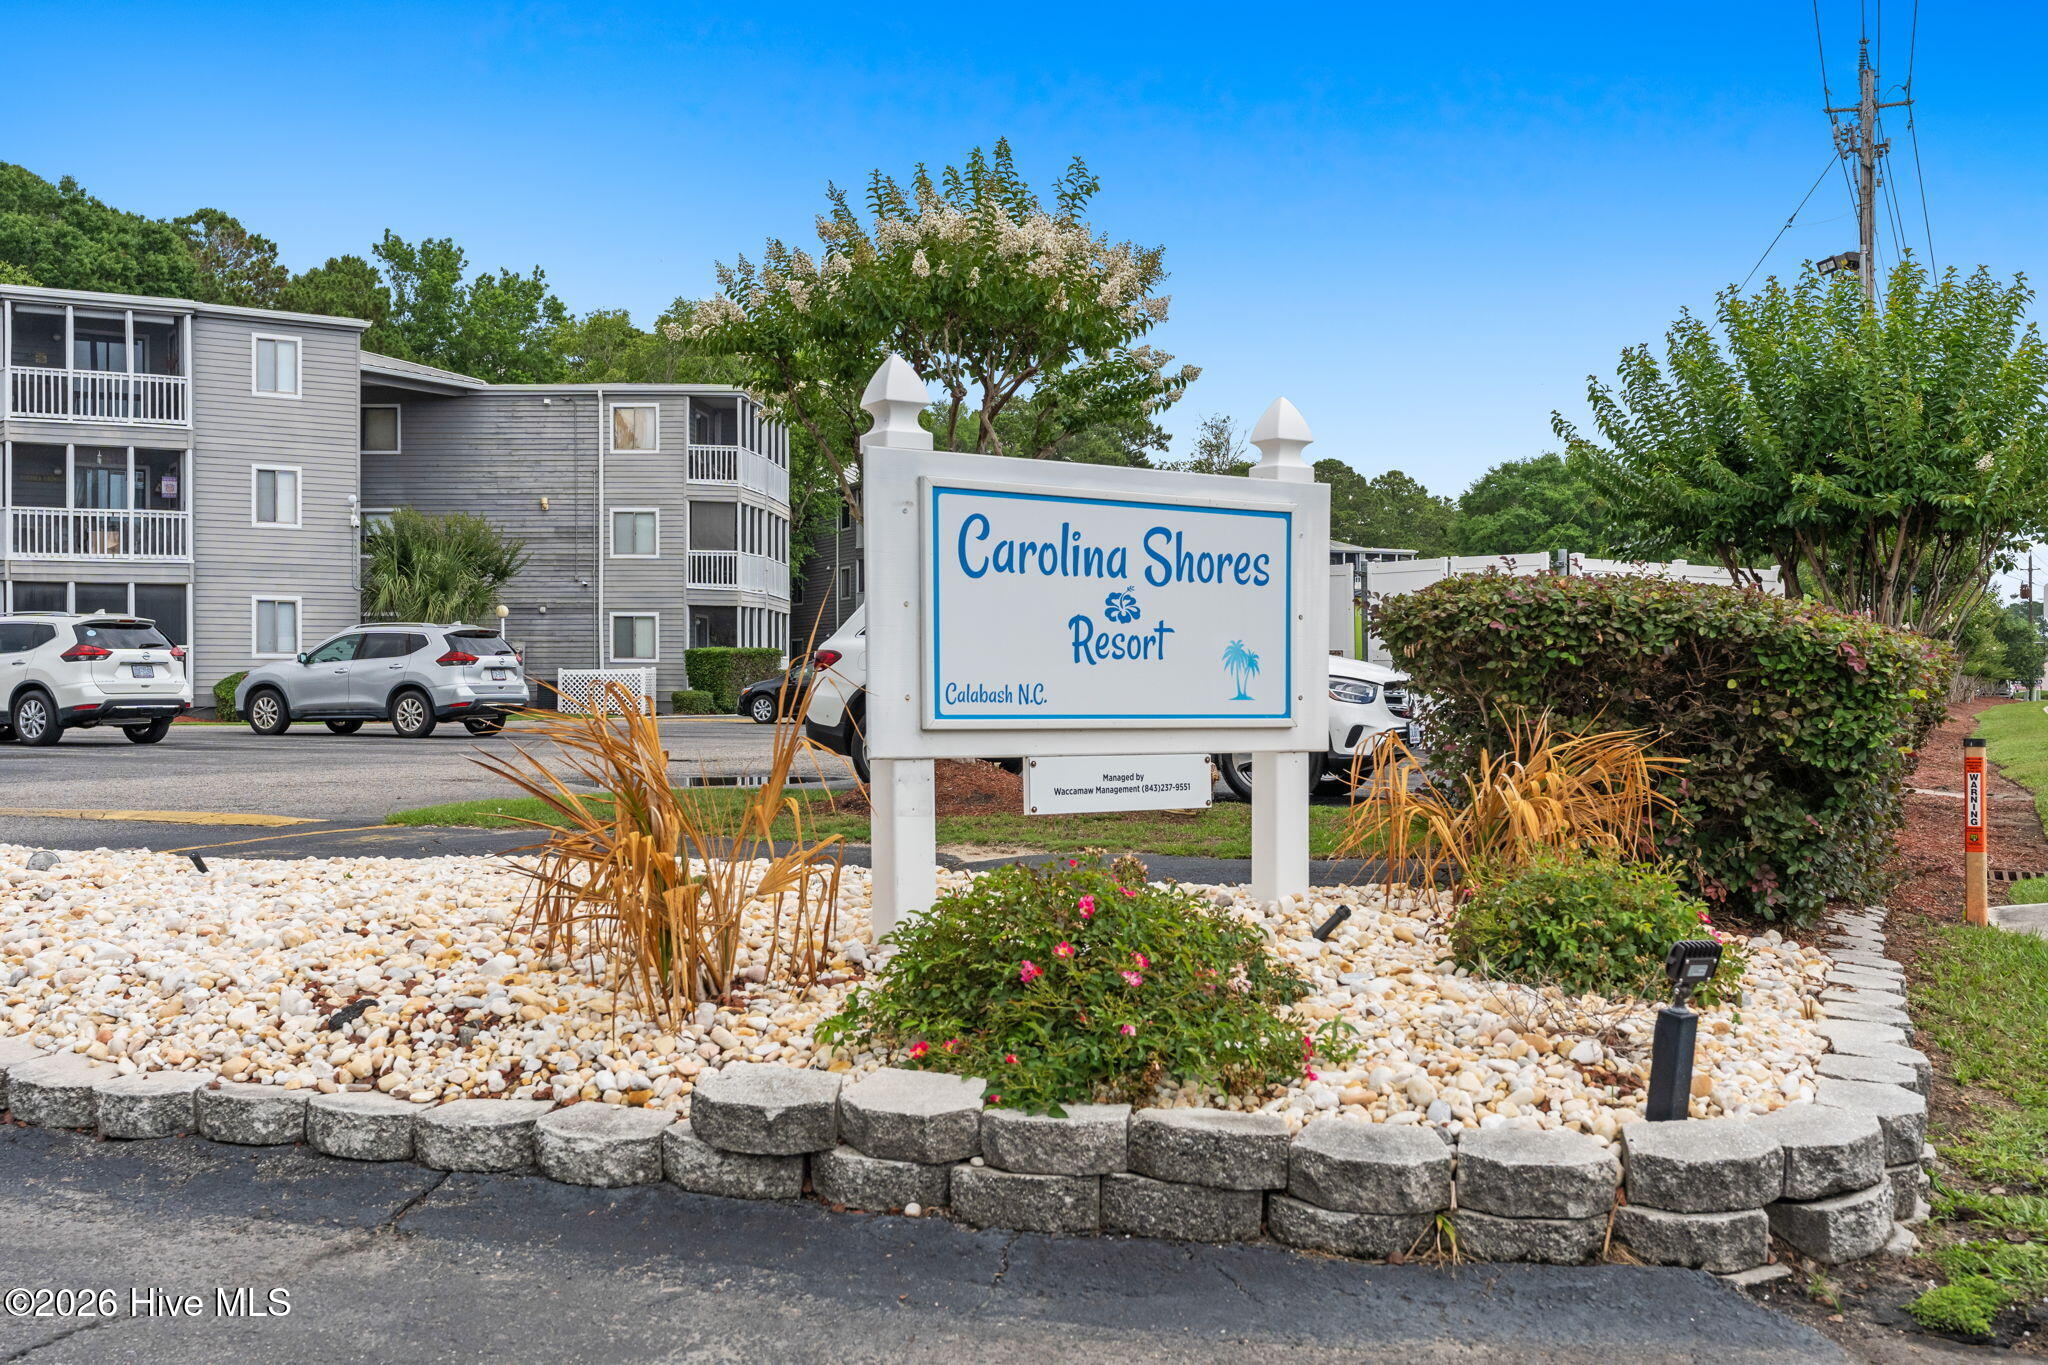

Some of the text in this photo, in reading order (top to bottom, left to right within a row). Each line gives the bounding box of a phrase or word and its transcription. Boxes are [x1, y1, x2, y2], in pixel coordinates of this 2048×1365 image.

[958, 513, 1270, 587] Carolina Shores
[1068, 614, 1175, 665] Resort
[945, 683, 1048, 706] Calabash N.C.
[1054, 783, 1191, 796] Waccamaw Management (843)237-9551
[1102, 773, 1144, 782] Managed by
[1969, 773, 1979, 826] WARNING
